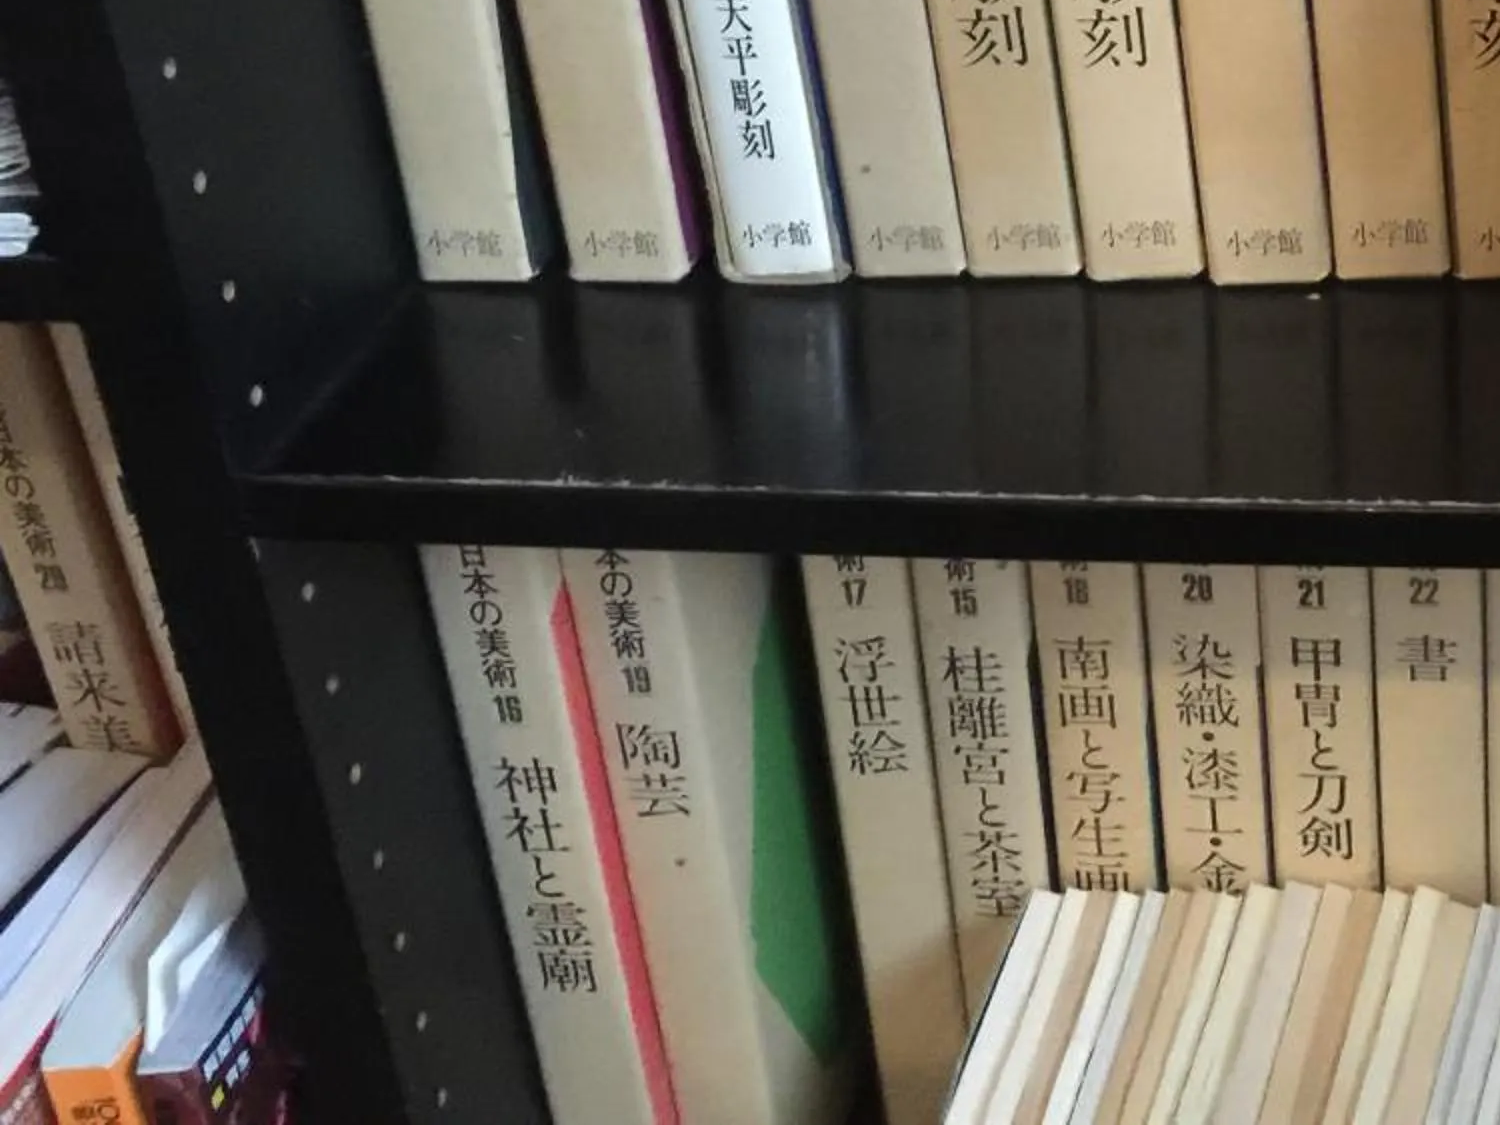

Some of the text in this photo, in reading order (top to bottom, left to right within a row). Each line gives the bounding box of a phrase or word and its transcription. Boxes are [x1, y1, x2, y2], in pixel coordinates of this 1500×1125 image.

[425, 229, 502, 258] 小学館
[584, 231, 659, 258] 小学館
[741, 222, 812, 248] 小学館
[868, 224, 944, 252] 小学館
[985, 222, 1062, 251] 小学館
[1101, 219, 1176, 249] 小学館
[1226, 227, 1303, 257] 小学館
[1352, 219, 1430, 249] 小学館
[842, 579, 868, 608] 17
[951, 589, 978, 617] 15
[1298, 579, 1325, 609] 21
[1410, 577, 1440, 607] 22
[1398, 633, 1457, 683] 書
[622, 665, 652, 694] 19
[492, 695, 523, 723] 16
[834, 635, 909, 776] 浮世絵
[1291, 636, 1353, 860] 甲冑と刀剣
[615, 722, 691, 818] 陶芸
[942, 644, 1023, 918] 桂離宮と茶室
[496, 758, 598, 993] 神社と霊廟
